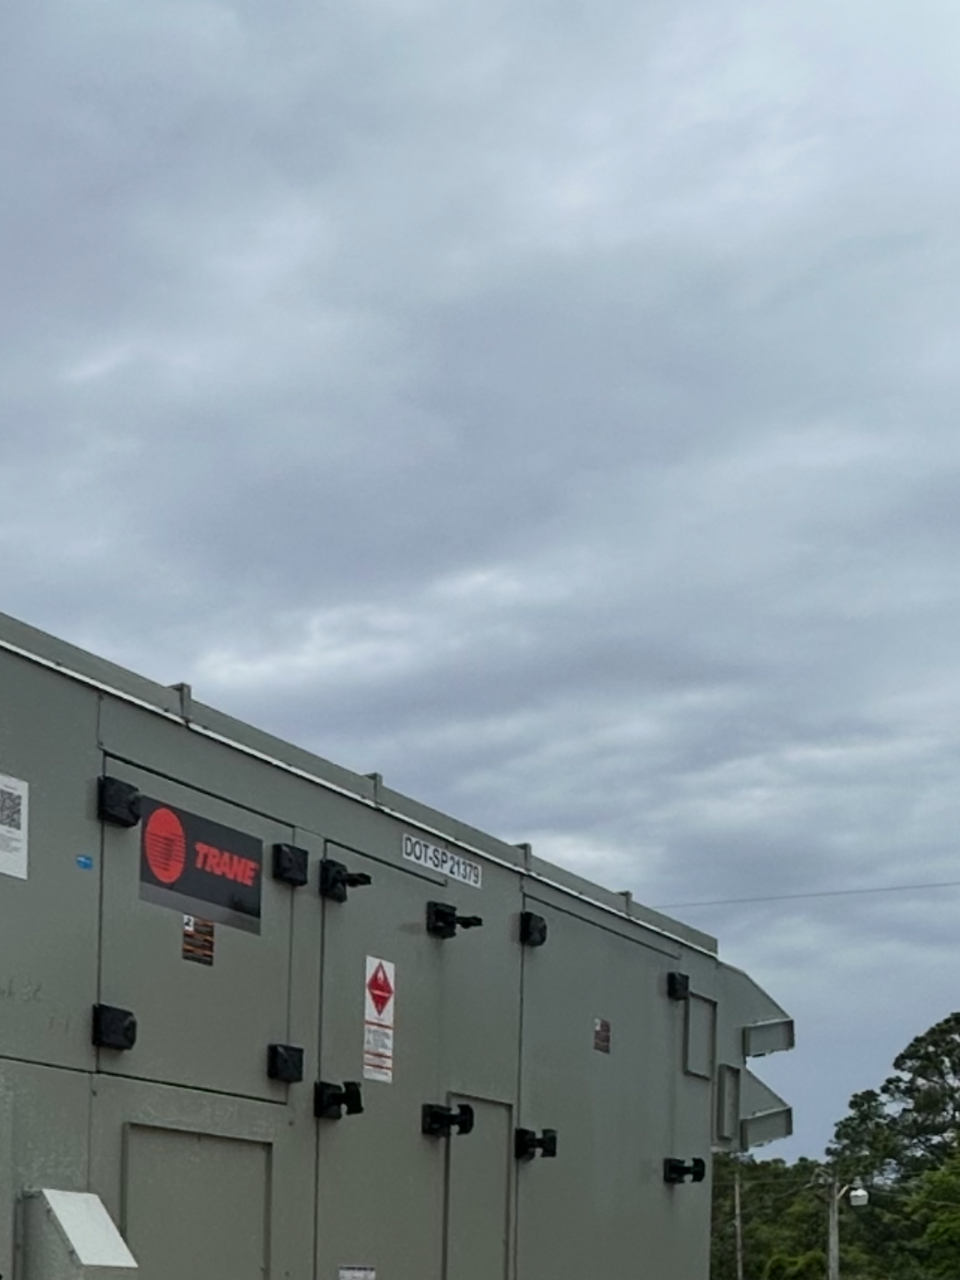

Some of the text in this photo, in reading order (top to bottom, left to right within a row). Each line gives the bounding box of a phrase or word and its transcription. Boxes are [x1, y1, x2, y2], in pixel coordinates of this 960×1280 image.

[194, 841, 260, 887] TRANE
[404, 836, 480, 885] DOT-SP 21379
